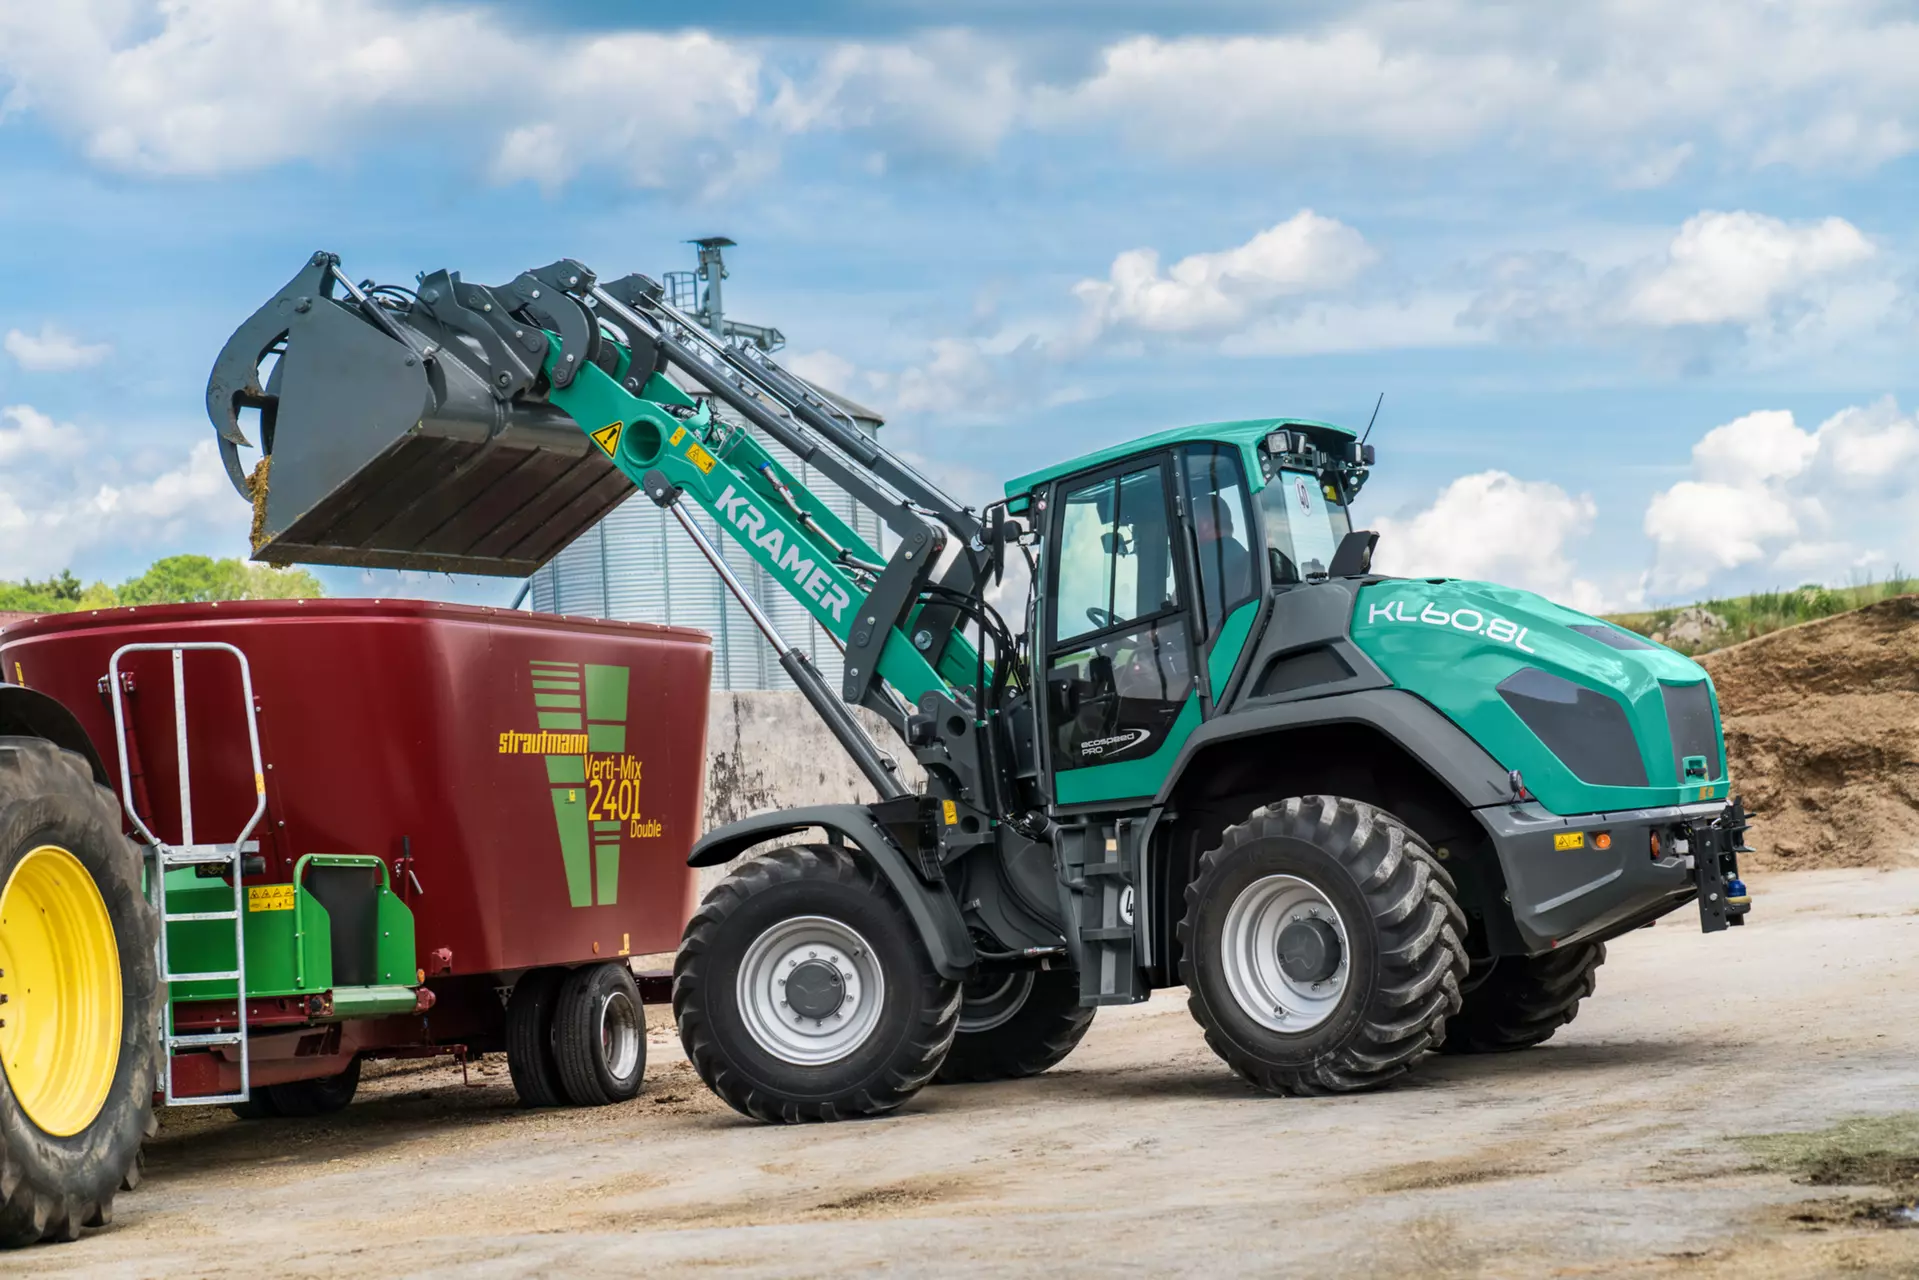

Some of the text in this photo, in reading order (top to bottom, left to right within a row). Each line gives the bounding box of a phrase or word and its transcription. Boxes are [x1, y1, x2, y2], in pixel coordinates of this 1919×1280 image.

[715, 484, 850, 623] KRAMER
[1368, 601, 1535, 653] KL60.8L
[499, 730, 588, 754] strautmann
[1081, 732, 1135, 748] ecospeed
[1082, 746, 1103, 756] PRO
[584, 755, 642, 779] Verti-Mix
[588, 779, 641, 820] 2401
[630, 819, 662, 838] Double
[1126, 890, 1133, 916] 4
